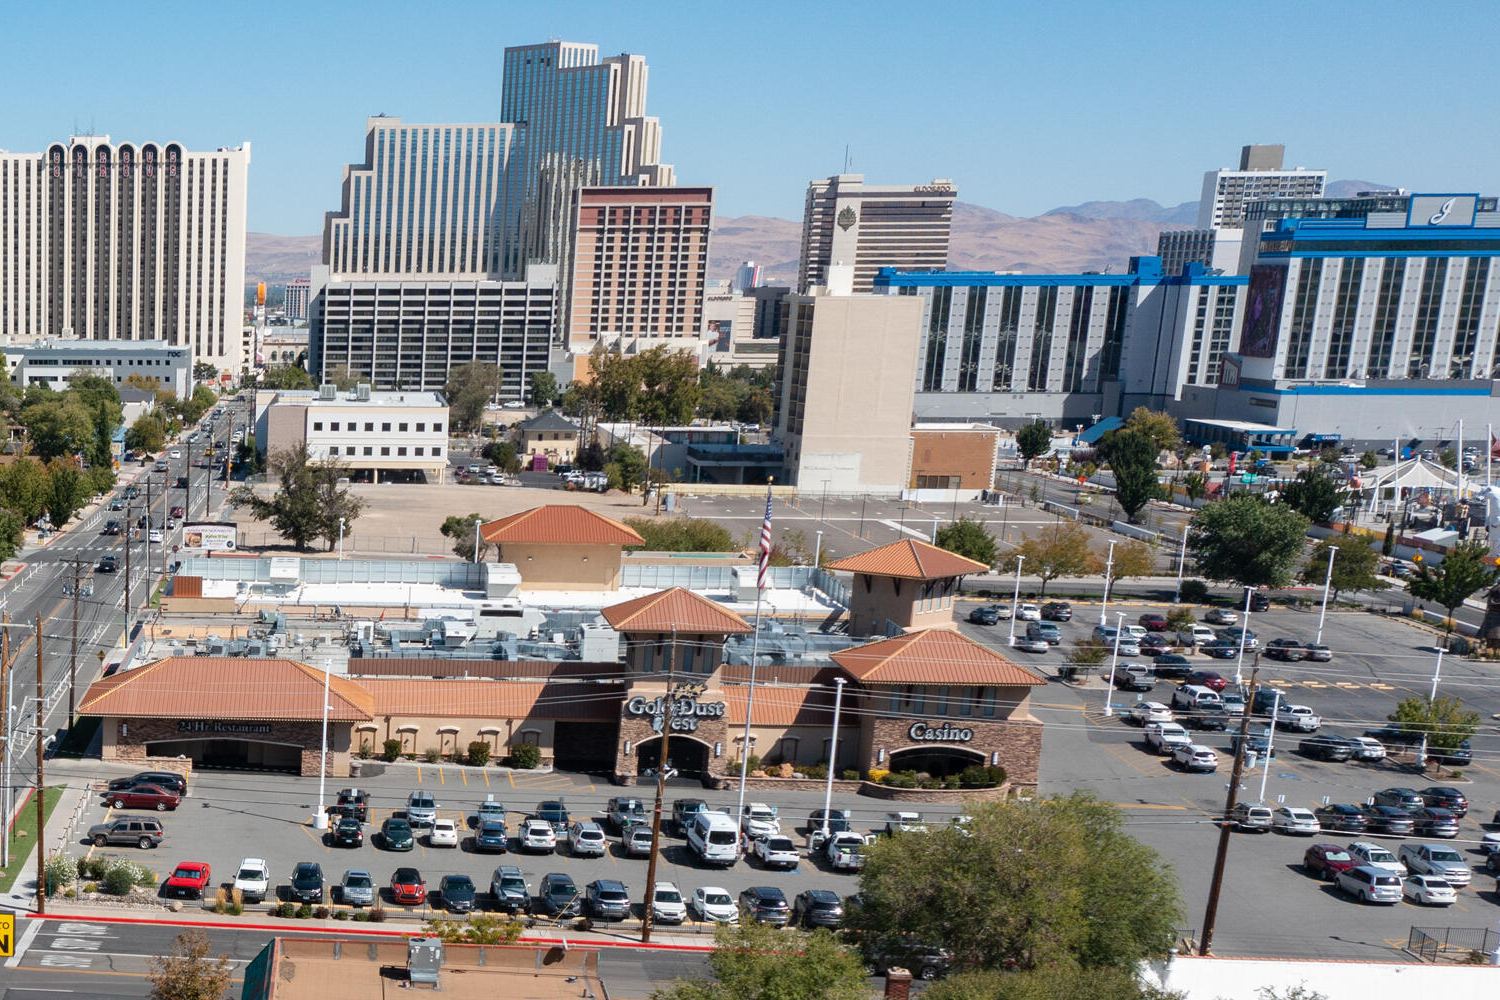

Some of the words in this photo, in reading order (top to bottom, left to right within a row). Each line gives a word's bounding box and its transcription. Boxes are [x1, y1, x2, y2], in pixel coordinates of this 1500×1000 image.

[677, 698, 724, 716] Dust
[179, 721, 192, 731] 24
[214, 722, 270, 733] Restaurant
[909, 722, 973, 741] Casino
